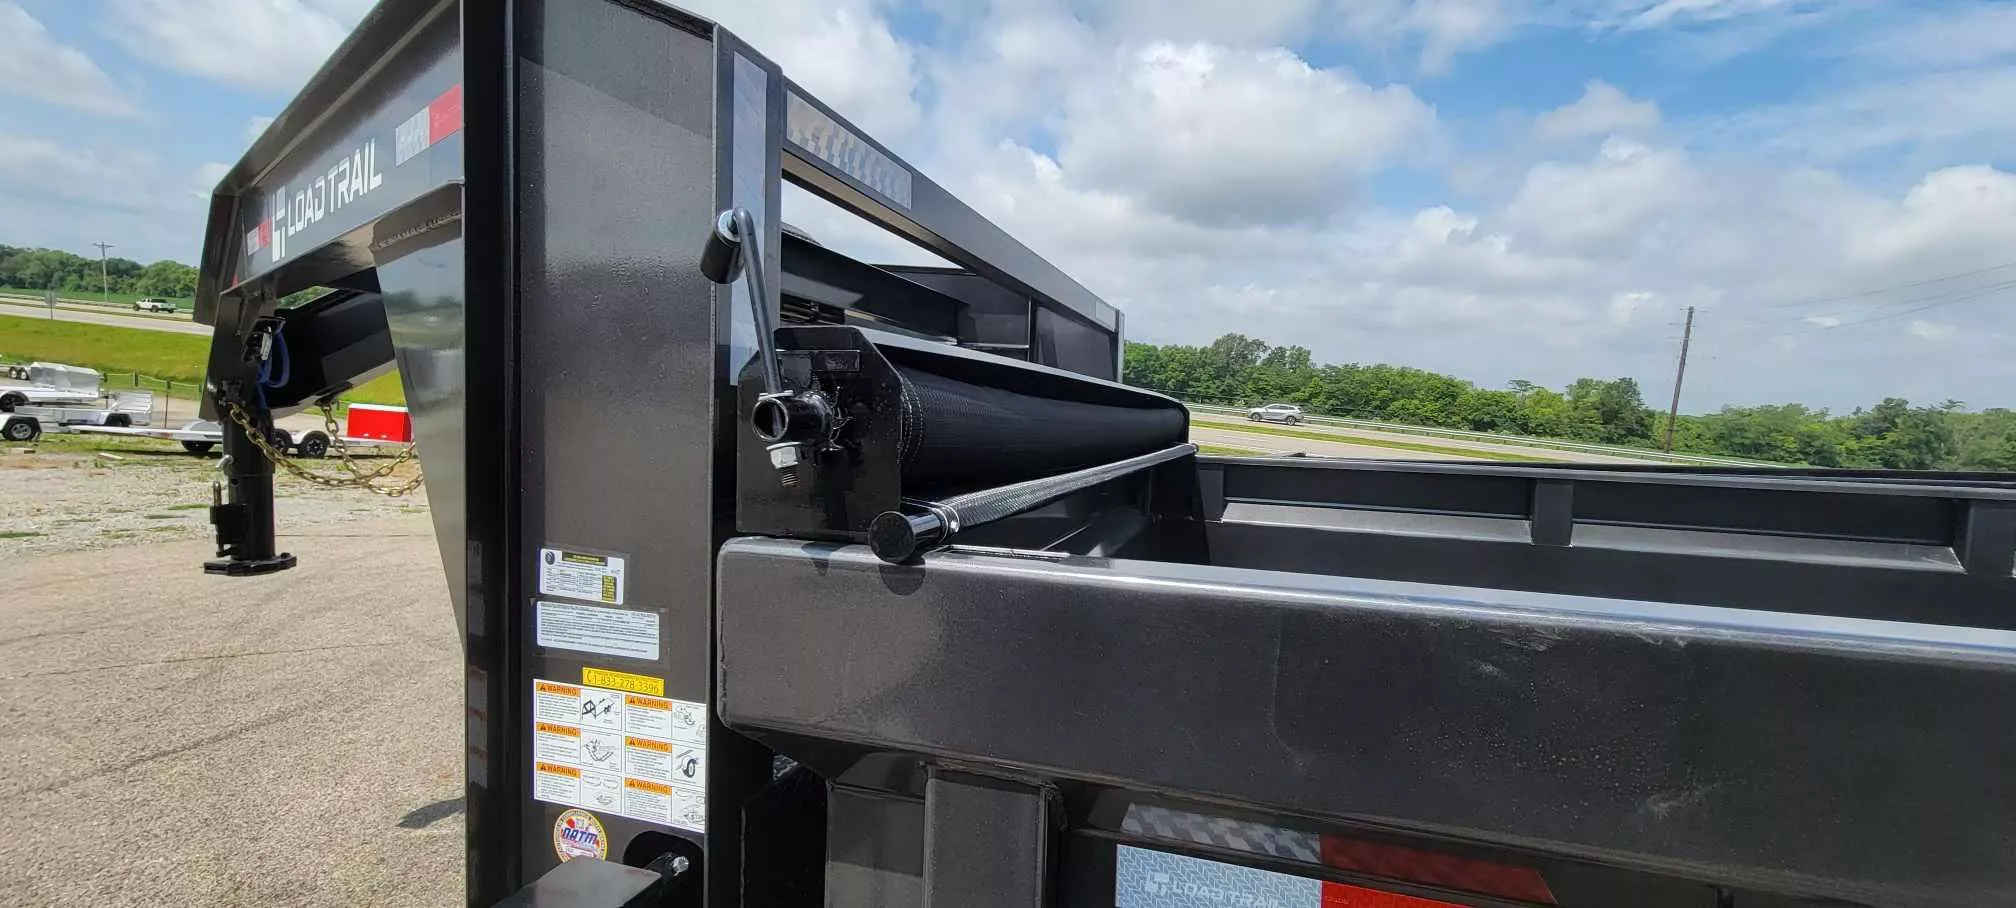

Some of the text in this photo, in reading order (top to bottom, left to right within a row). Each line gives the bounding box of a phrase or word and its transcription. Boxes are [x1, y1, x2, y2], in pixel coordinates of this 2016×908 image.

[288, 137, 383, 237] LOAD TRAIL
[546, 685, 578, 696] WARNING
[636, 697, 669, 710] WARNING
[546, 725, 578, 737] WARNING
[636, 738, 669, 751] WARNING
[546, 766, 578, 777] WARNING
[636, 780, 669, 793] WARNING
[1172, 881, 1224, 902] LOAD
